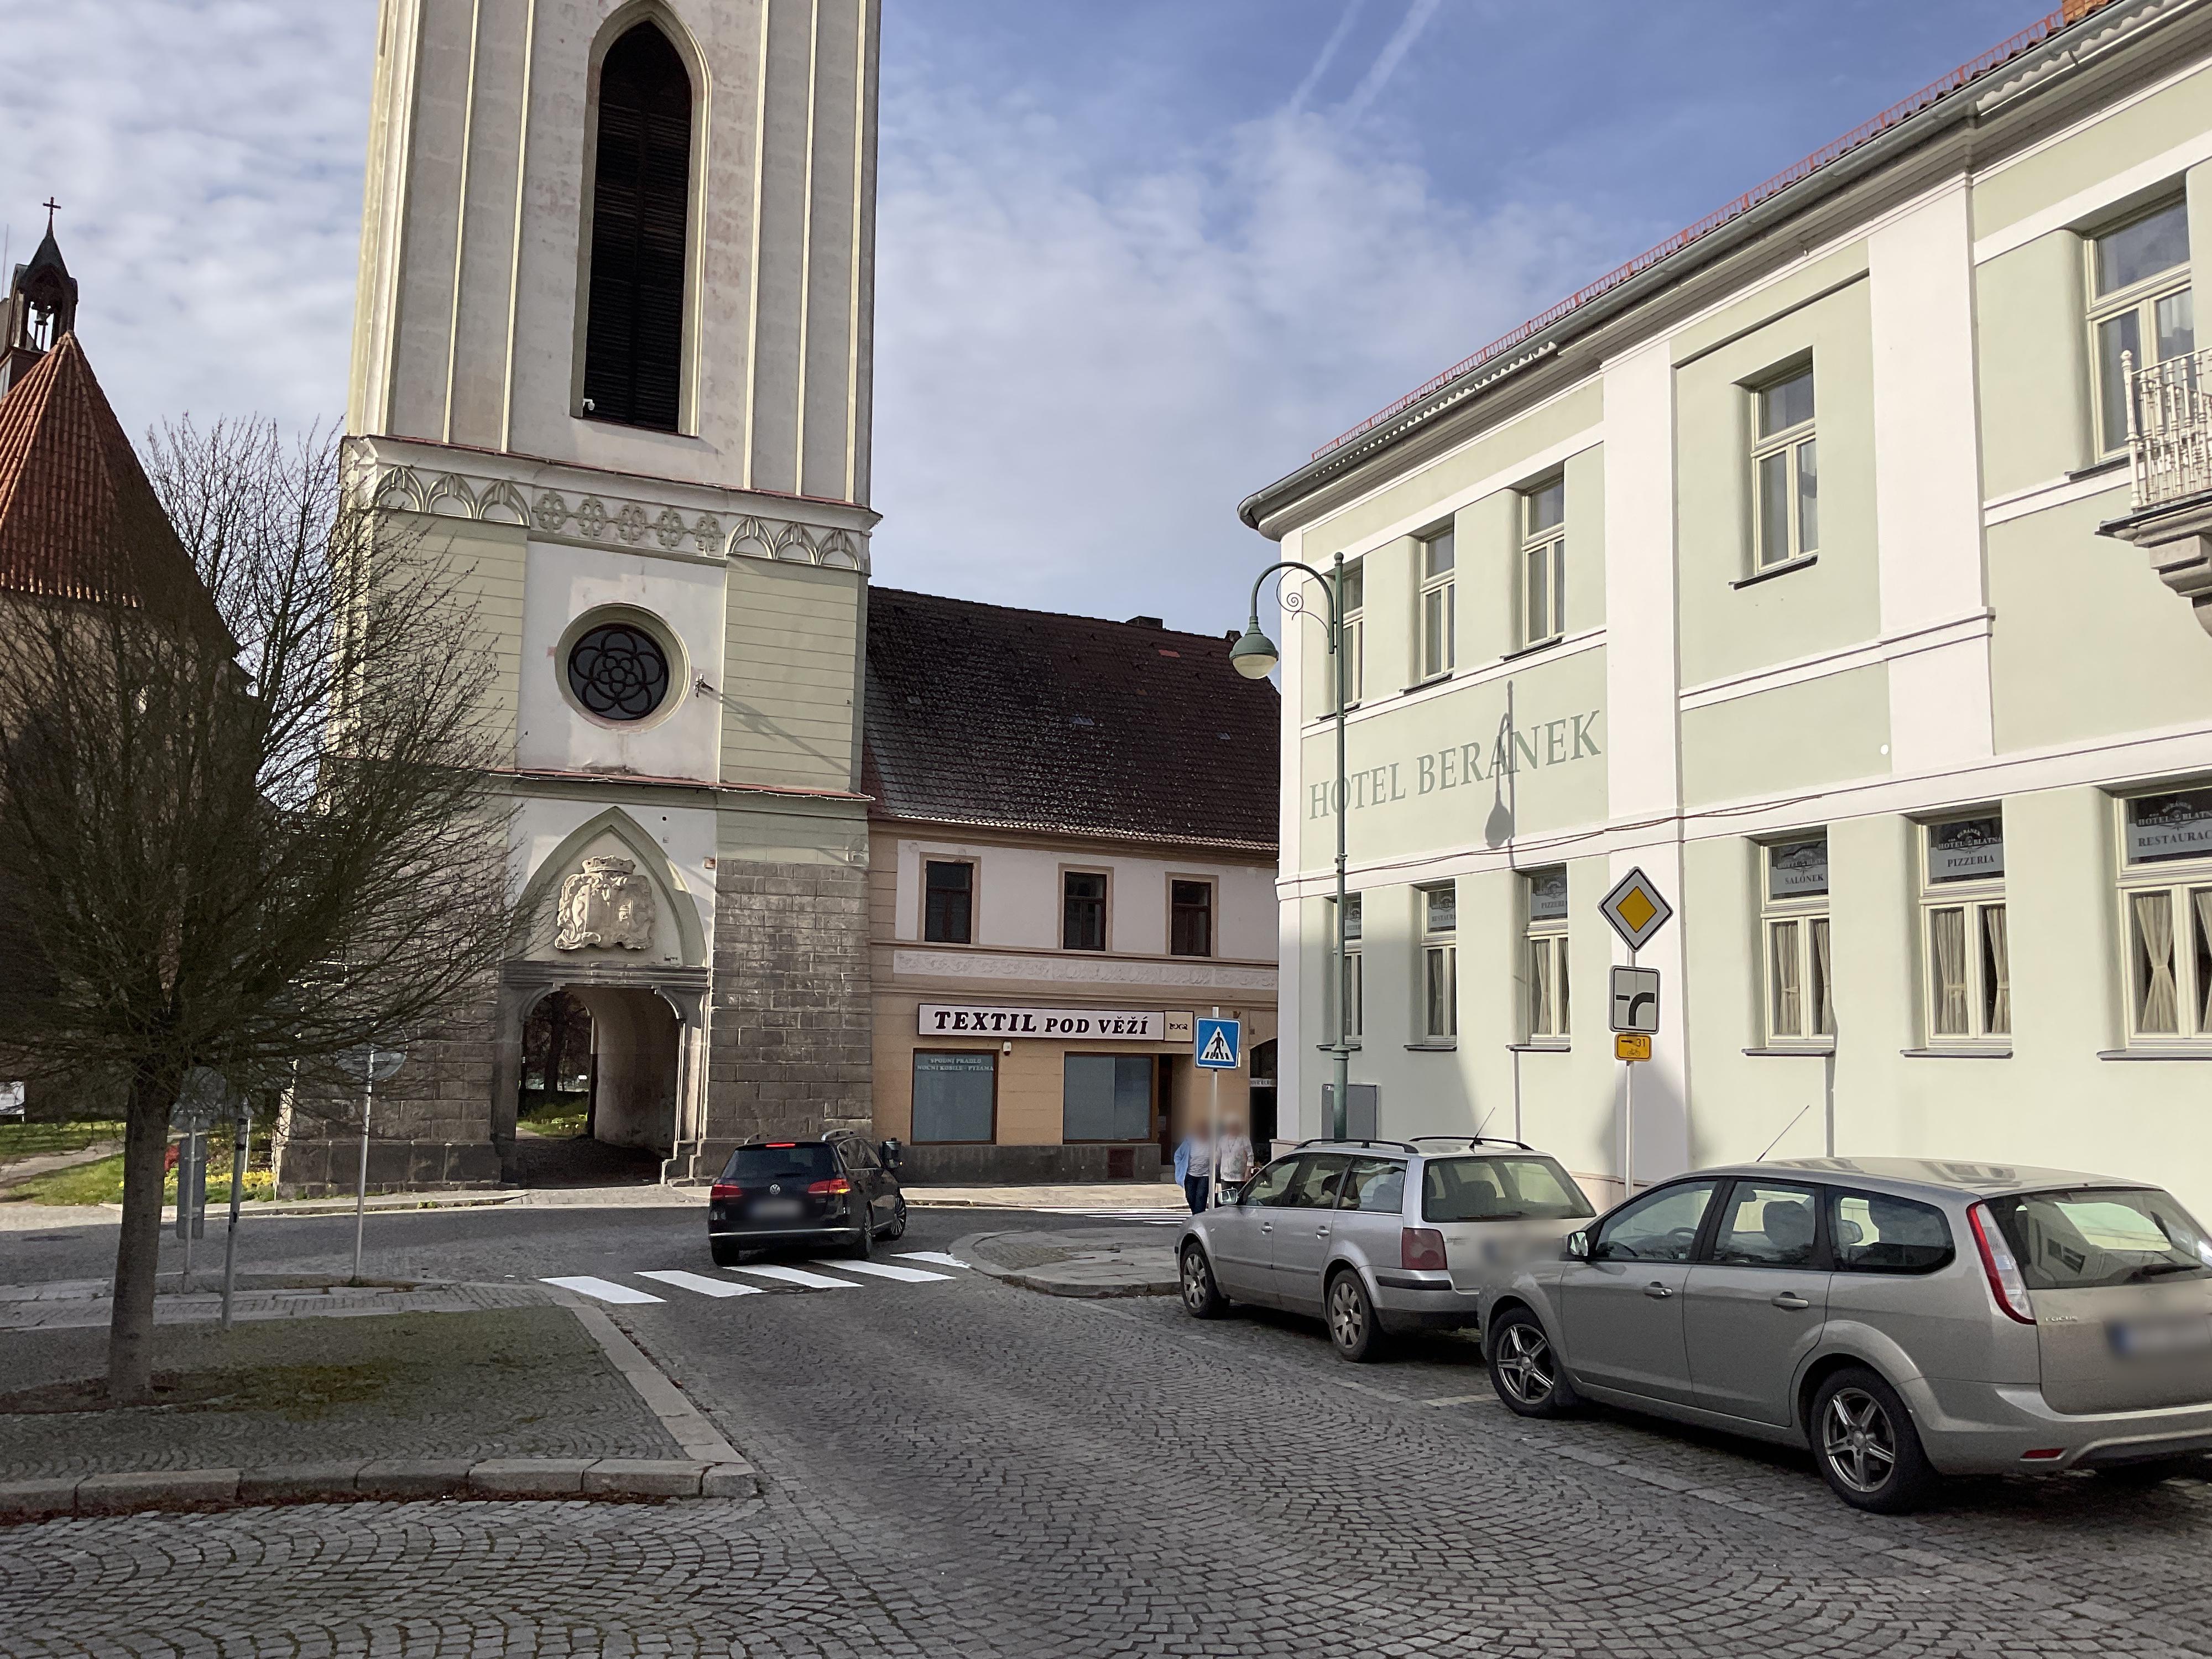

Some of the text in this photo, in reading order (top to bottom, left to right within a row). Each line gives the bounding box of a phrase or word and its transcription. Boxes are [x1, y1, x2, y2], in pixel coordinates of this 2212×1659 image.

[1309, 709, 1601, 820] HOTEL BERÁNEK
[1938, 841, 1964, 850] HOTEL
[1947, 854, 1994, 867] PIZZERIA
[934, 1011, 1149, 1035] TEXTIL POD VĚŽÍ
[1636, 1038, 1645, 1047] 31
